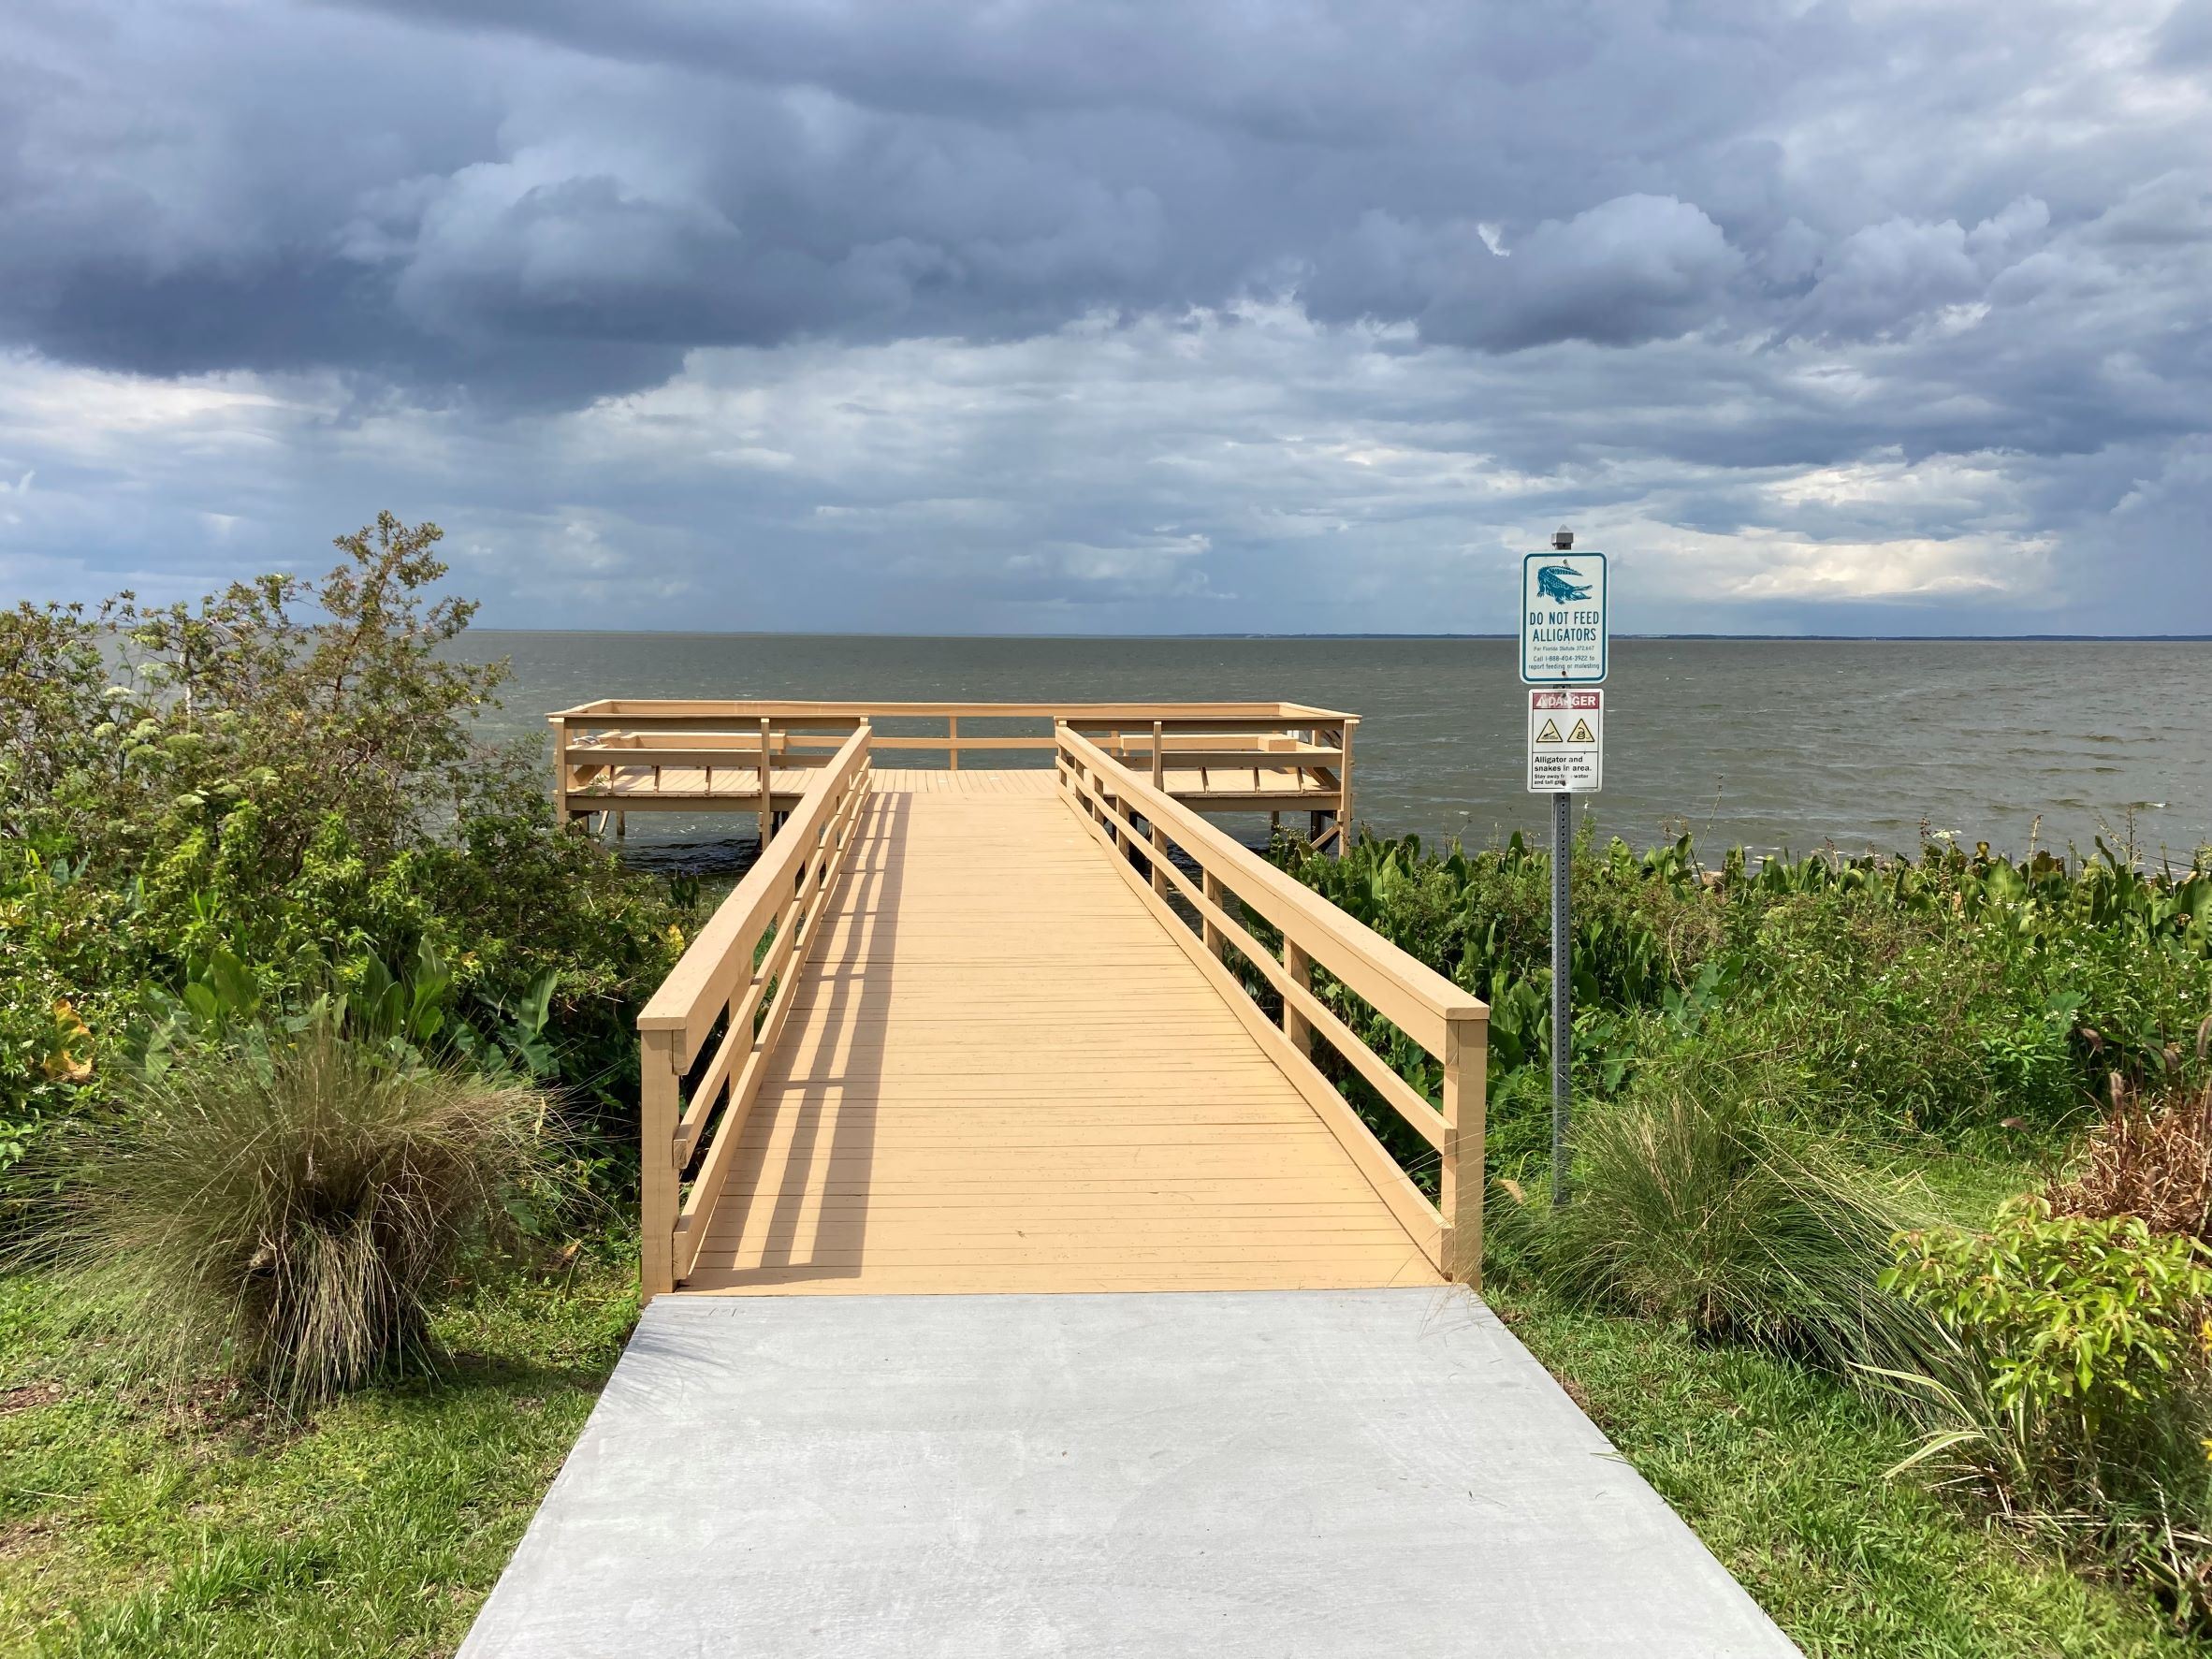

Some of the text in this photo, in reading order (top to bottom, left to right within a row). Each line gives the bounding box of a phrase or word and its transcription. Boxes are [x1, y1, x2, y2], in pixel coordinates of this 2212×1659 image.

[1529, 611, 1599, 625] DO NOT FEED
[1533, 628, 1596, 641] ALLIGATORS
